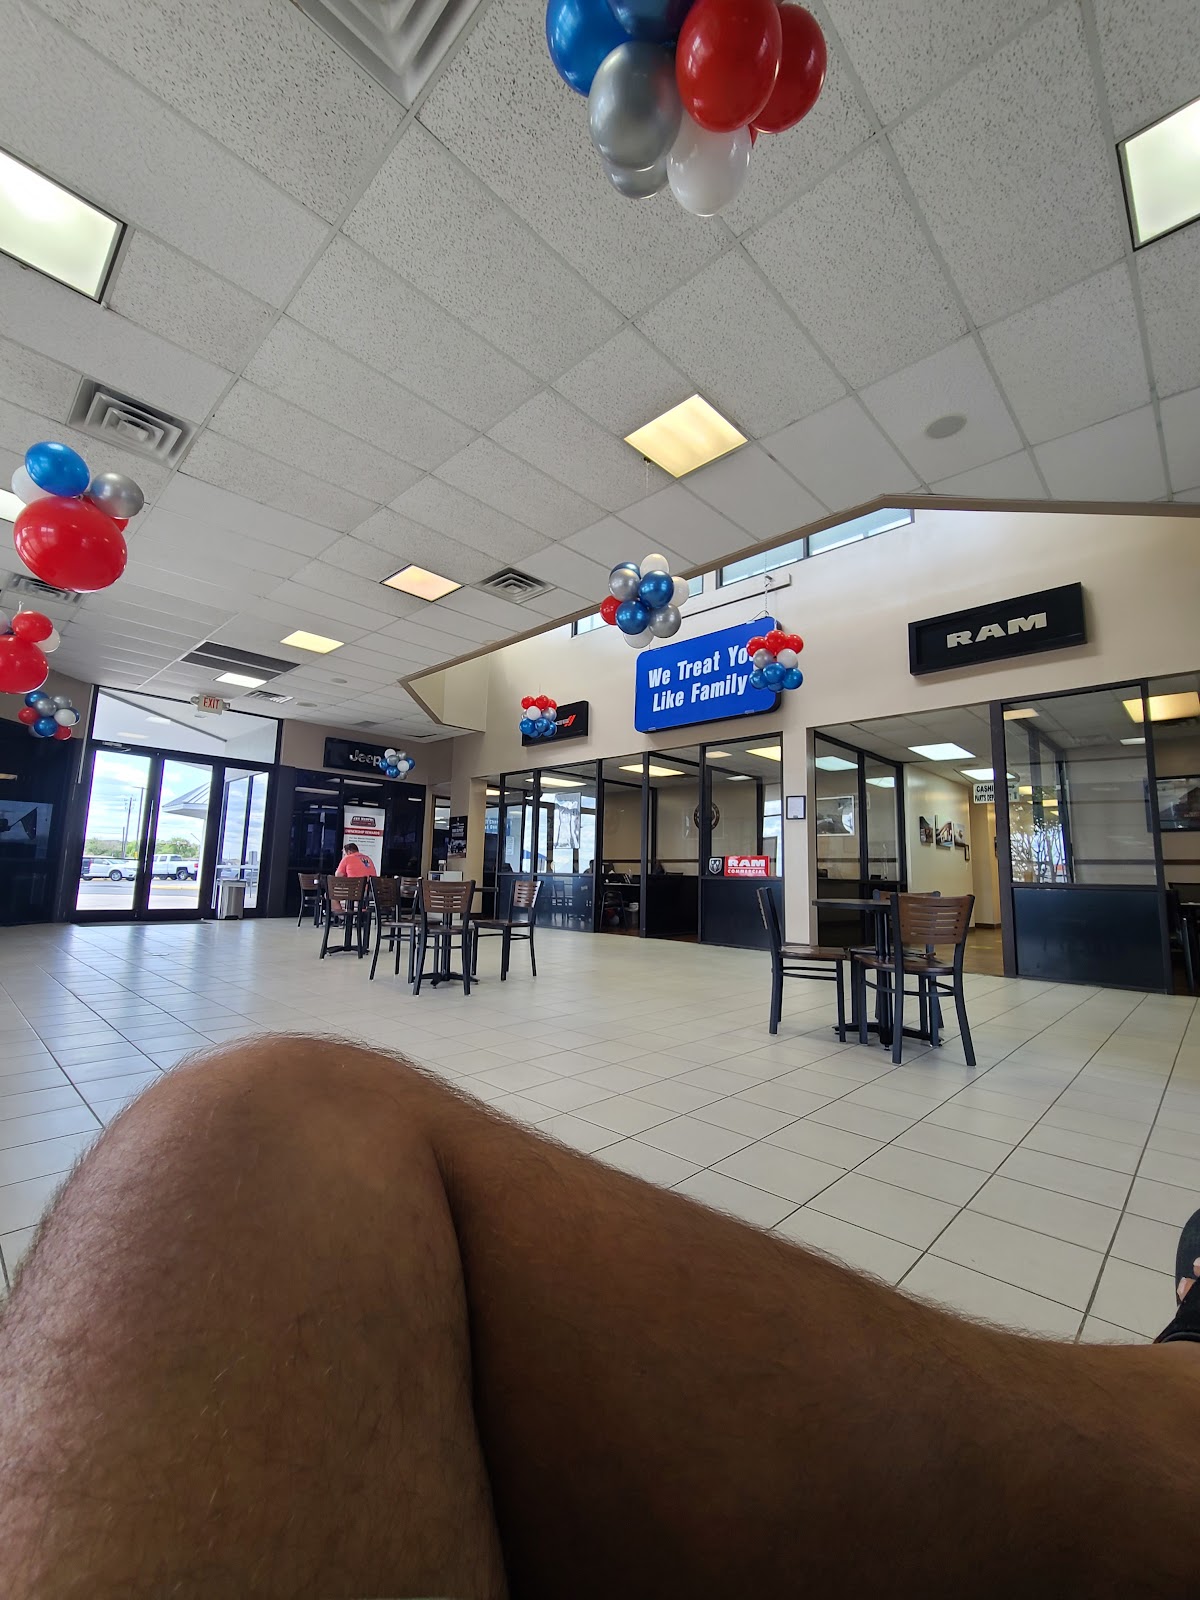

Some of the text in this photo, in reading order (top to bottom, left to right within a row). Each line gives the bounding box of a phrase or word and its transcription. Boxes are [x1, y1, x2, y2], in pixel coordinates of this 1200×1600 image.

[946, 612, 1048, 649] RAM
[648, 644, 754, 689] We Treat Yo
[203, 697, 220, 709] EXIT
[652, 673, 748, 712] Like Family
[349, 749, 382, 767] Jeep
[727, 859, 766, 867] RAM
